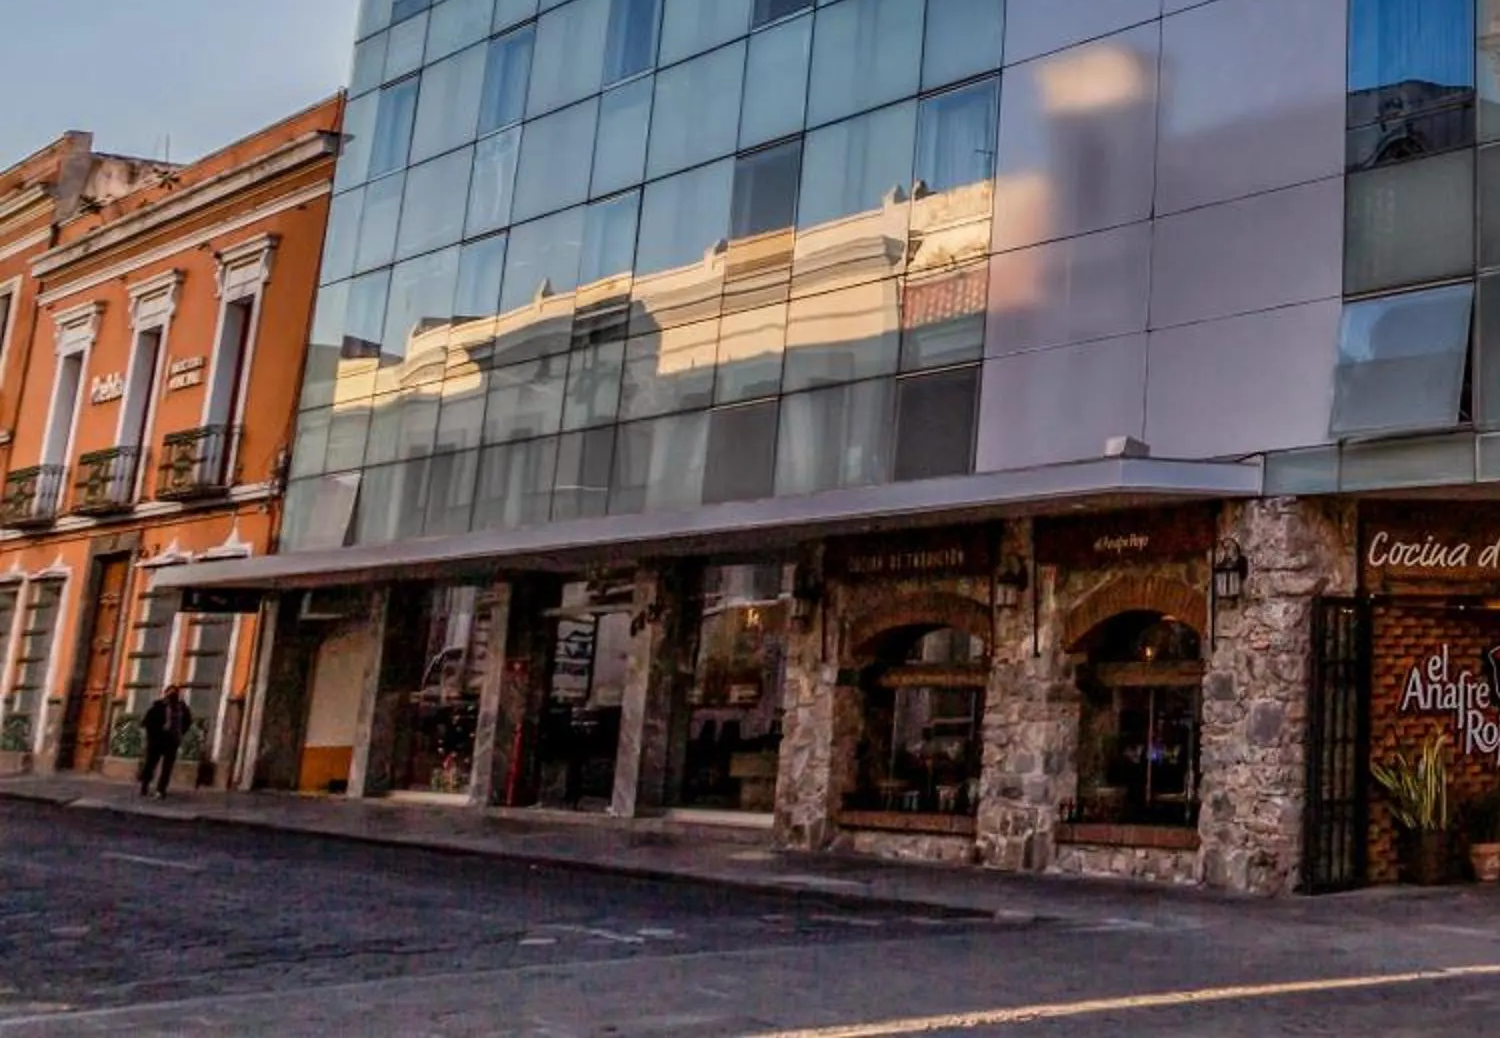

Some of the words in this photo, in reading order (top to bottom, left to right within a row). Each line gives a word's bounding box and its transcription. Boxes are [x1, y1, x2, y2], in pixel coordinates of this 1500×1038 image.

[1368, 530, 1467, 569] Cocina
[1427, 643, 1450, 681] el
[1402, 667, 1490, 728] Anafre
